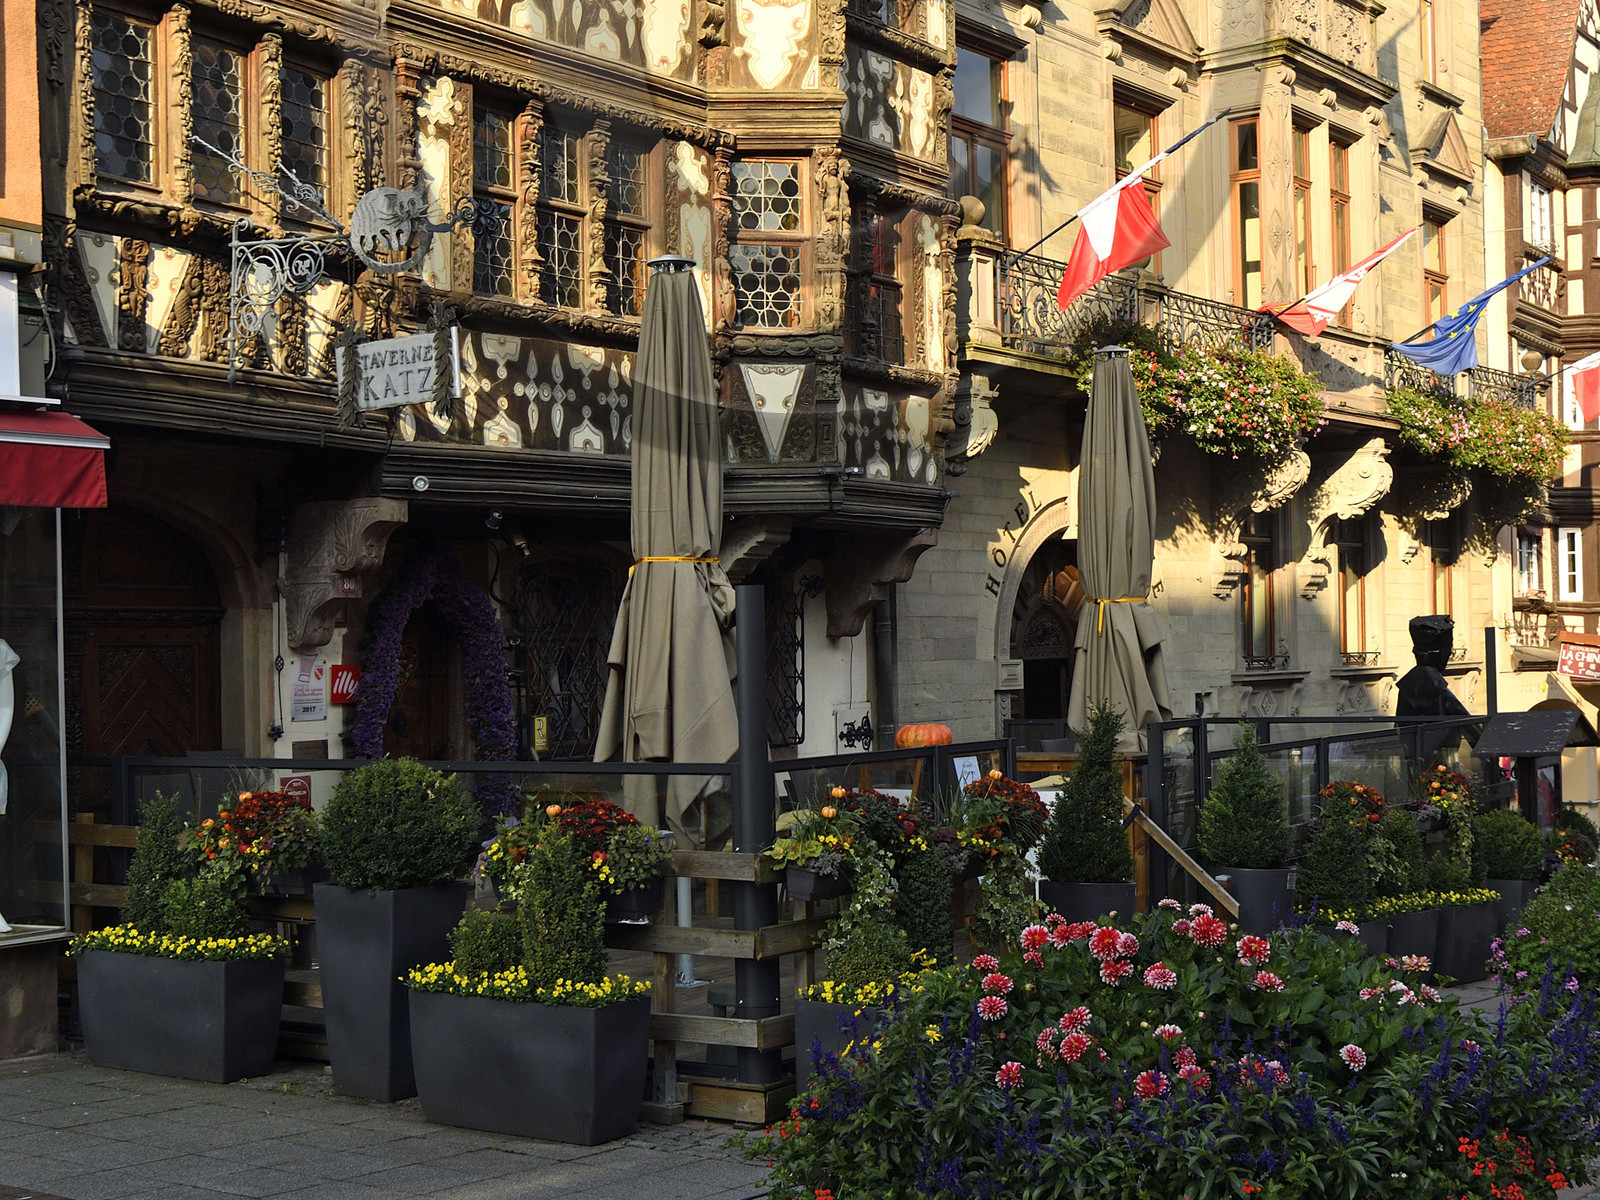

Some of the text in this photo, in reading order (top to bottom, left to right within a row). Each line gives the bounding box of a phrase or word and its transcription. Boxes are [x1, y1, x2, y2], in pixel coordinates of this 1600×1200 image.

[361, 345, 433, 370] TAVERNE
[362, 366, 434, 400] KATZ
[985, 491, 1042, 598] HÔTEL
[343, 578, 355, 590] 80
[1562, 649, 1600, 663] LA CHIN
[333, 671, 358, 700] illy
